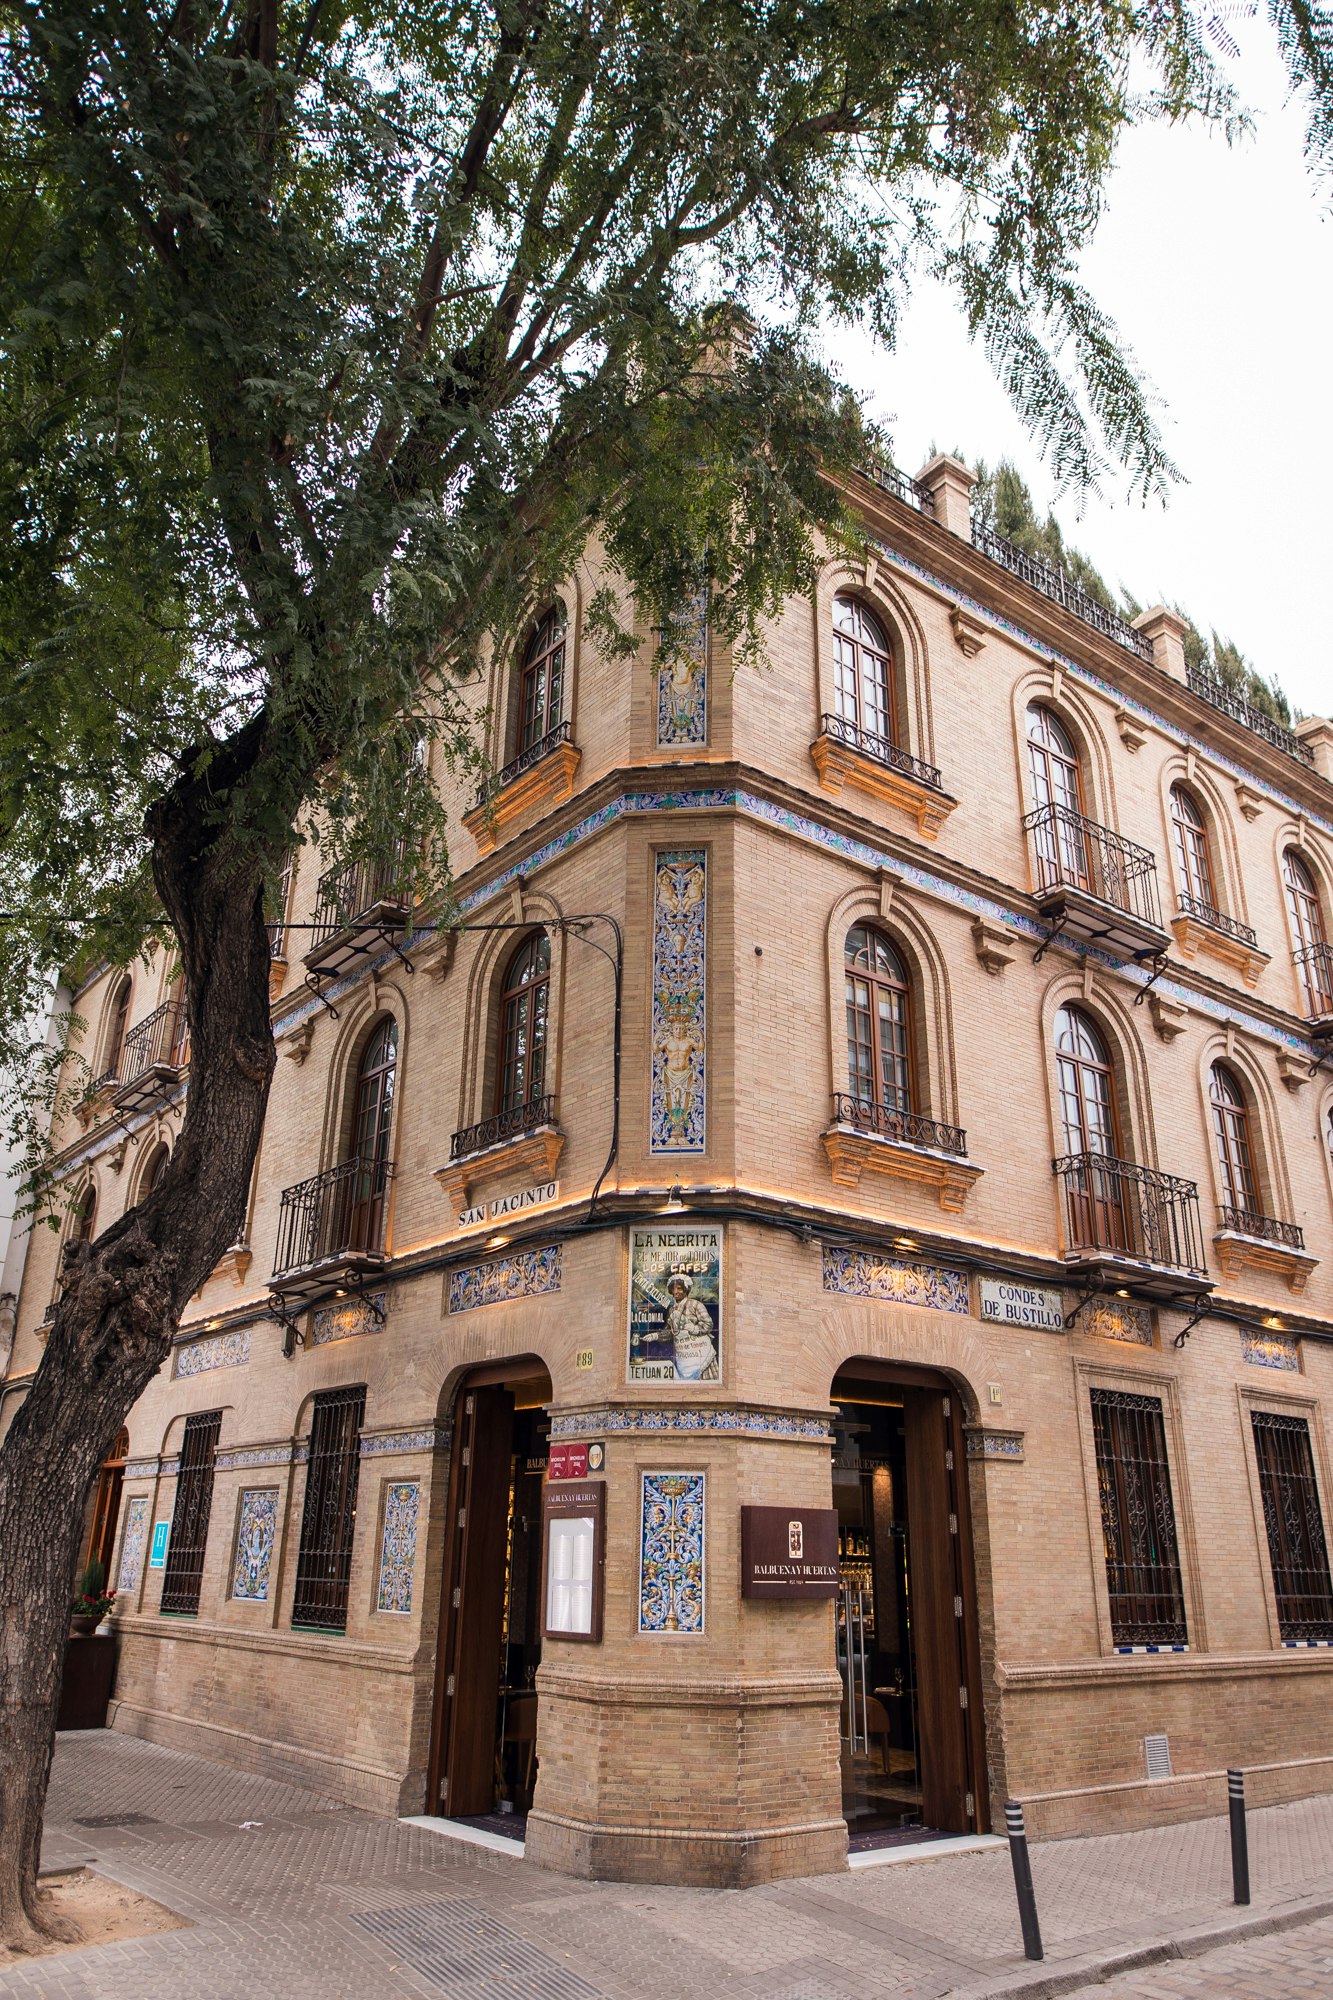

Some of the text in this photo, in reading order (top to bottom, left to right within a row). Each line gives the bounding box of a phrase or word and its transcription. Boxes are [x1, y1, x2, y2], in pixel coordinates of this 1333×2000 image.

[459, 1183, 556, 1226] SAN JACINTO
[634, 1234, 718, 1247] LA NEGRITA
[651, 1251, 679, 1262] MEJOR
[688, 1251, 716, 1262] TODOS
[643, 1263, 665, 1272] LOS
[998, 1285, 1045, 1307] CONDES
[984, 1300, 1062, 1328] DE BUSTILLO
[581, 1351, 593, 1366] 89
[631, 1366, 674, 1379] TETUAN 20
[754, 1564, 796, 1575] BALBUENA
[803, 1565, 837, 1576] HUERTAS
